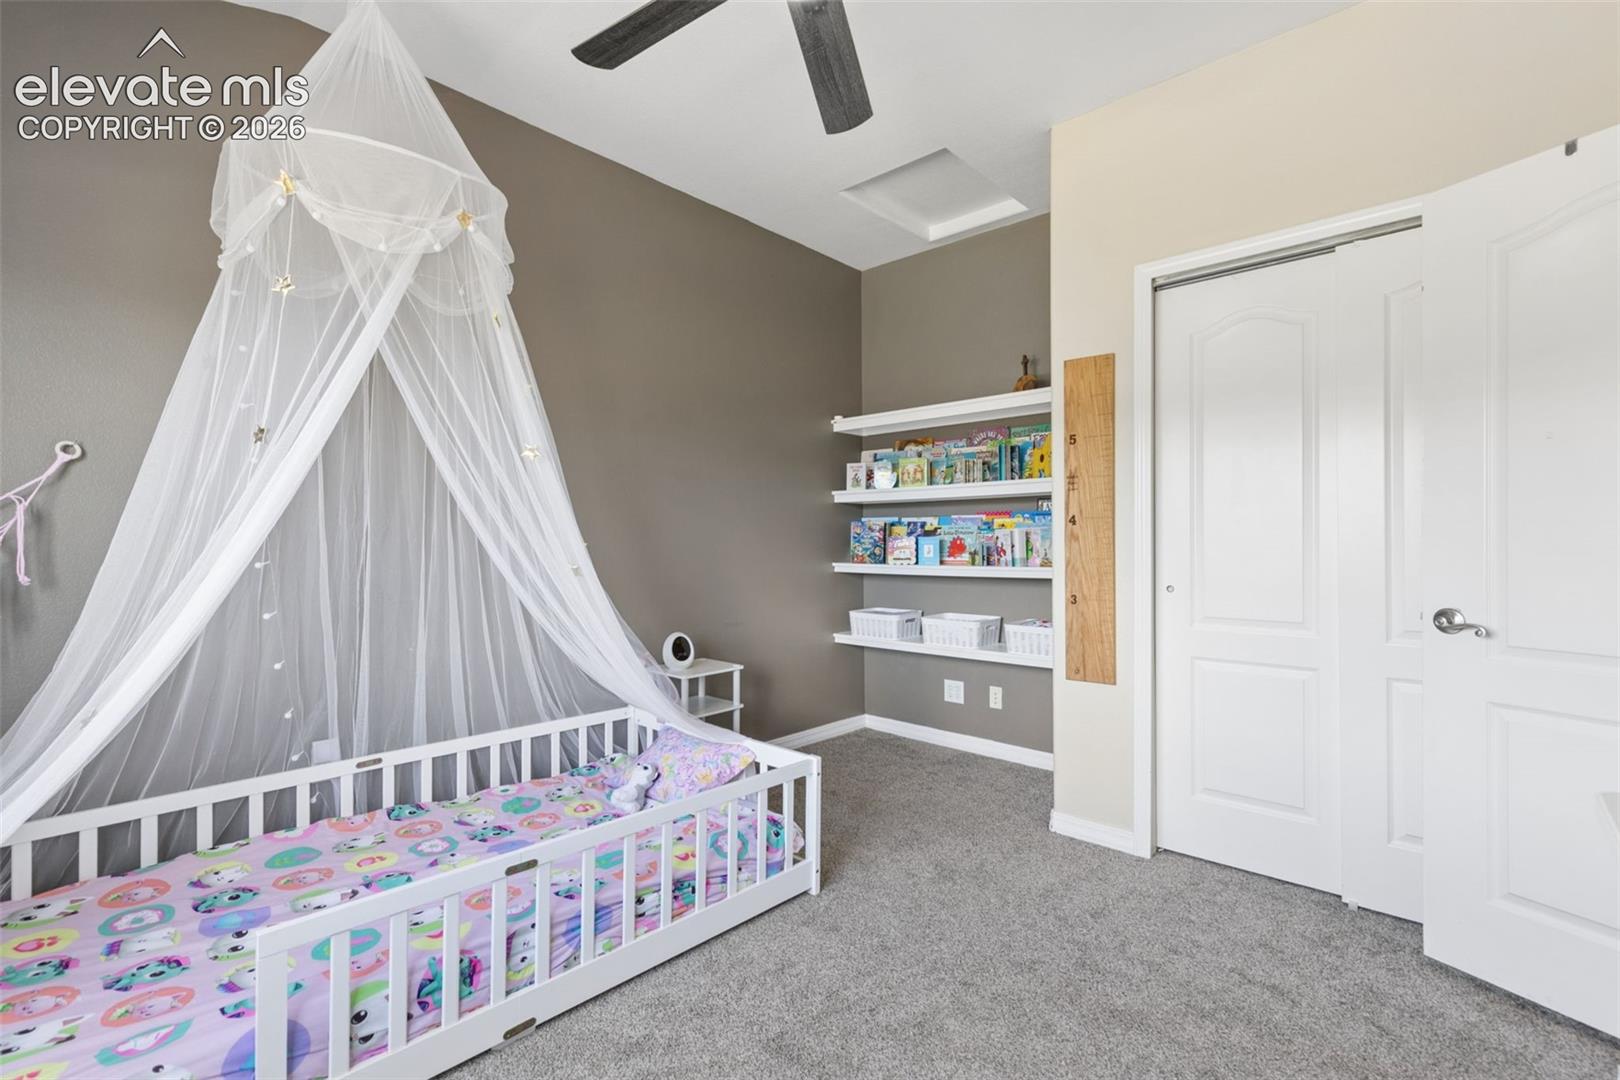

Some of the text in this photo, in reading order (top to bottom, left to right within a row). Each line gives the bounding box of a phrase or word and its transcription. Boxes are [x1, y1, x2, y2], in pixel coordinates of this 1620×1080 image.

[1069, 434, 1077, 446] 5
[1068, 514, 1077, 526] 4
[1070, 594, 1078, 605] 3
